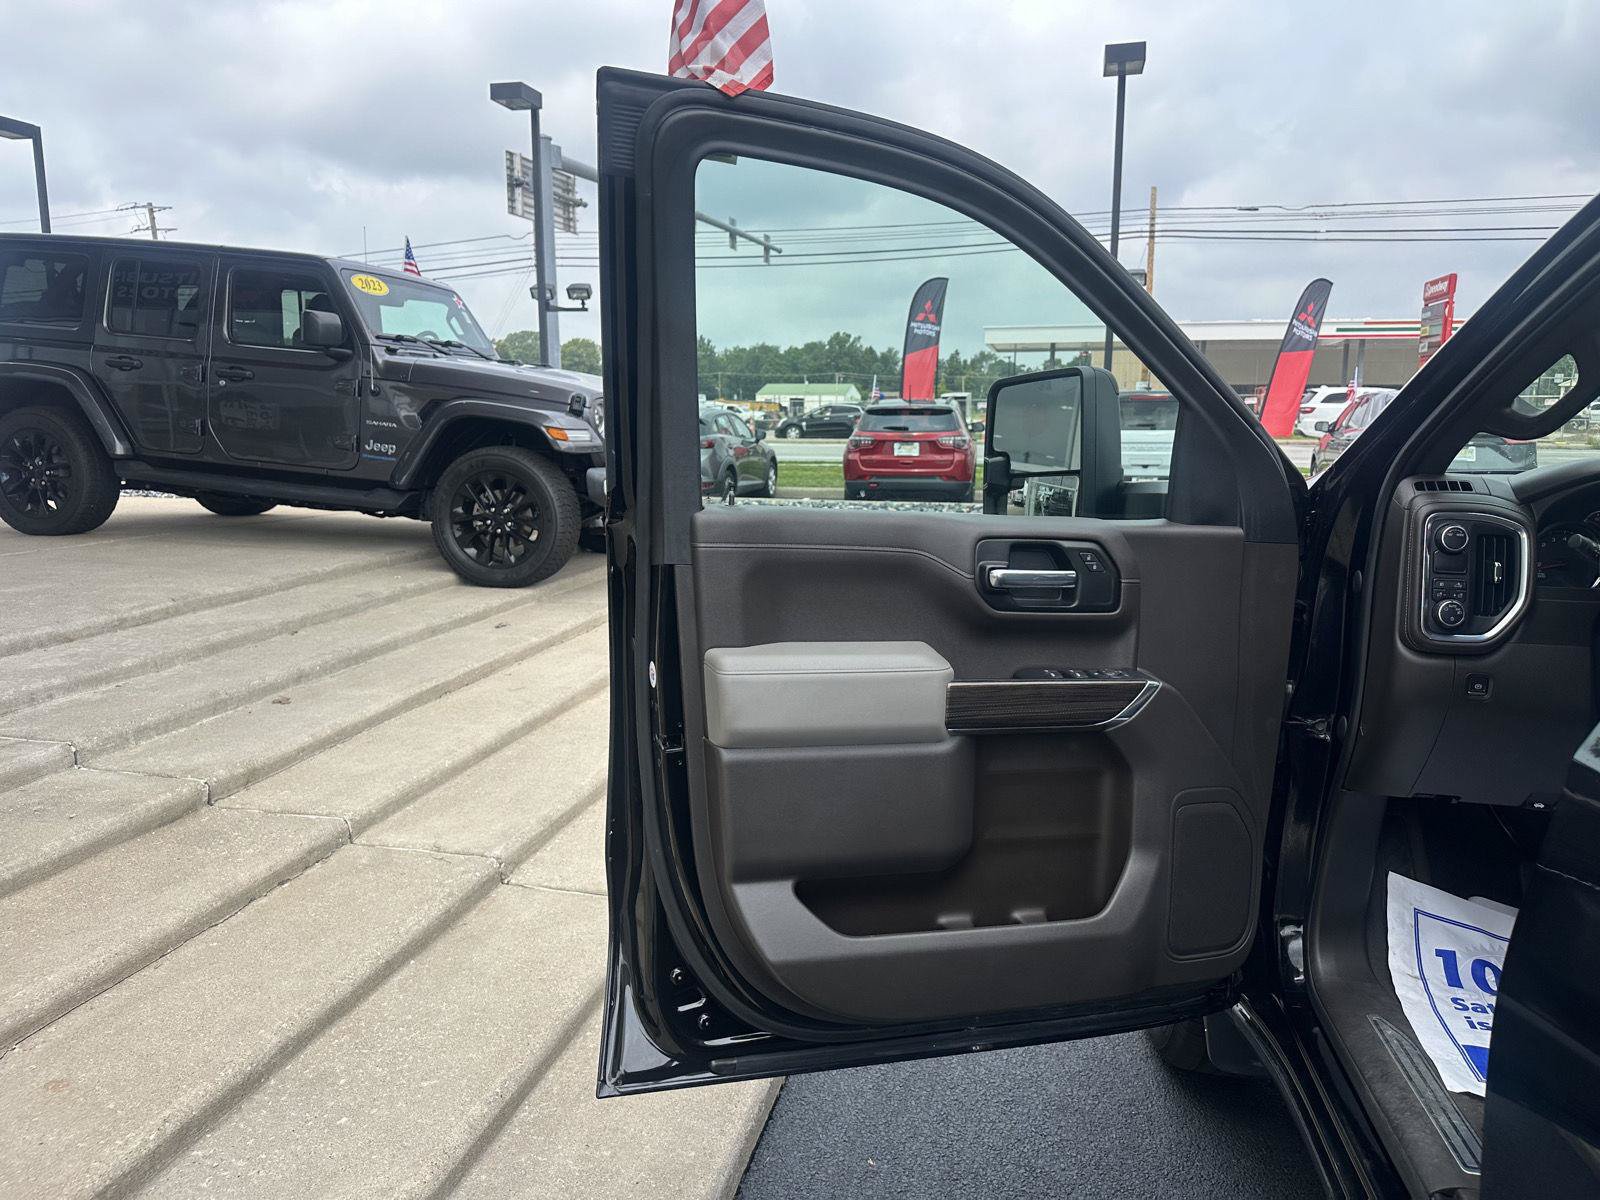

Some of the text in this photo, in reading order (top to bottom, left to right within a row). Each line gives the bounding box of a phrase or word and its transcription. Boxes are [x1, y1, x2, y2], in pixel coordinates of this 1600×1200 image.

[357, 277, 383, 292] 2023
[365, 420, 397, 428] SAHARA
[364, 439, 397, 455] Jeep
[1434, 948, 1503, 997] 10
[1464, 1015, 1492, 1031] is
